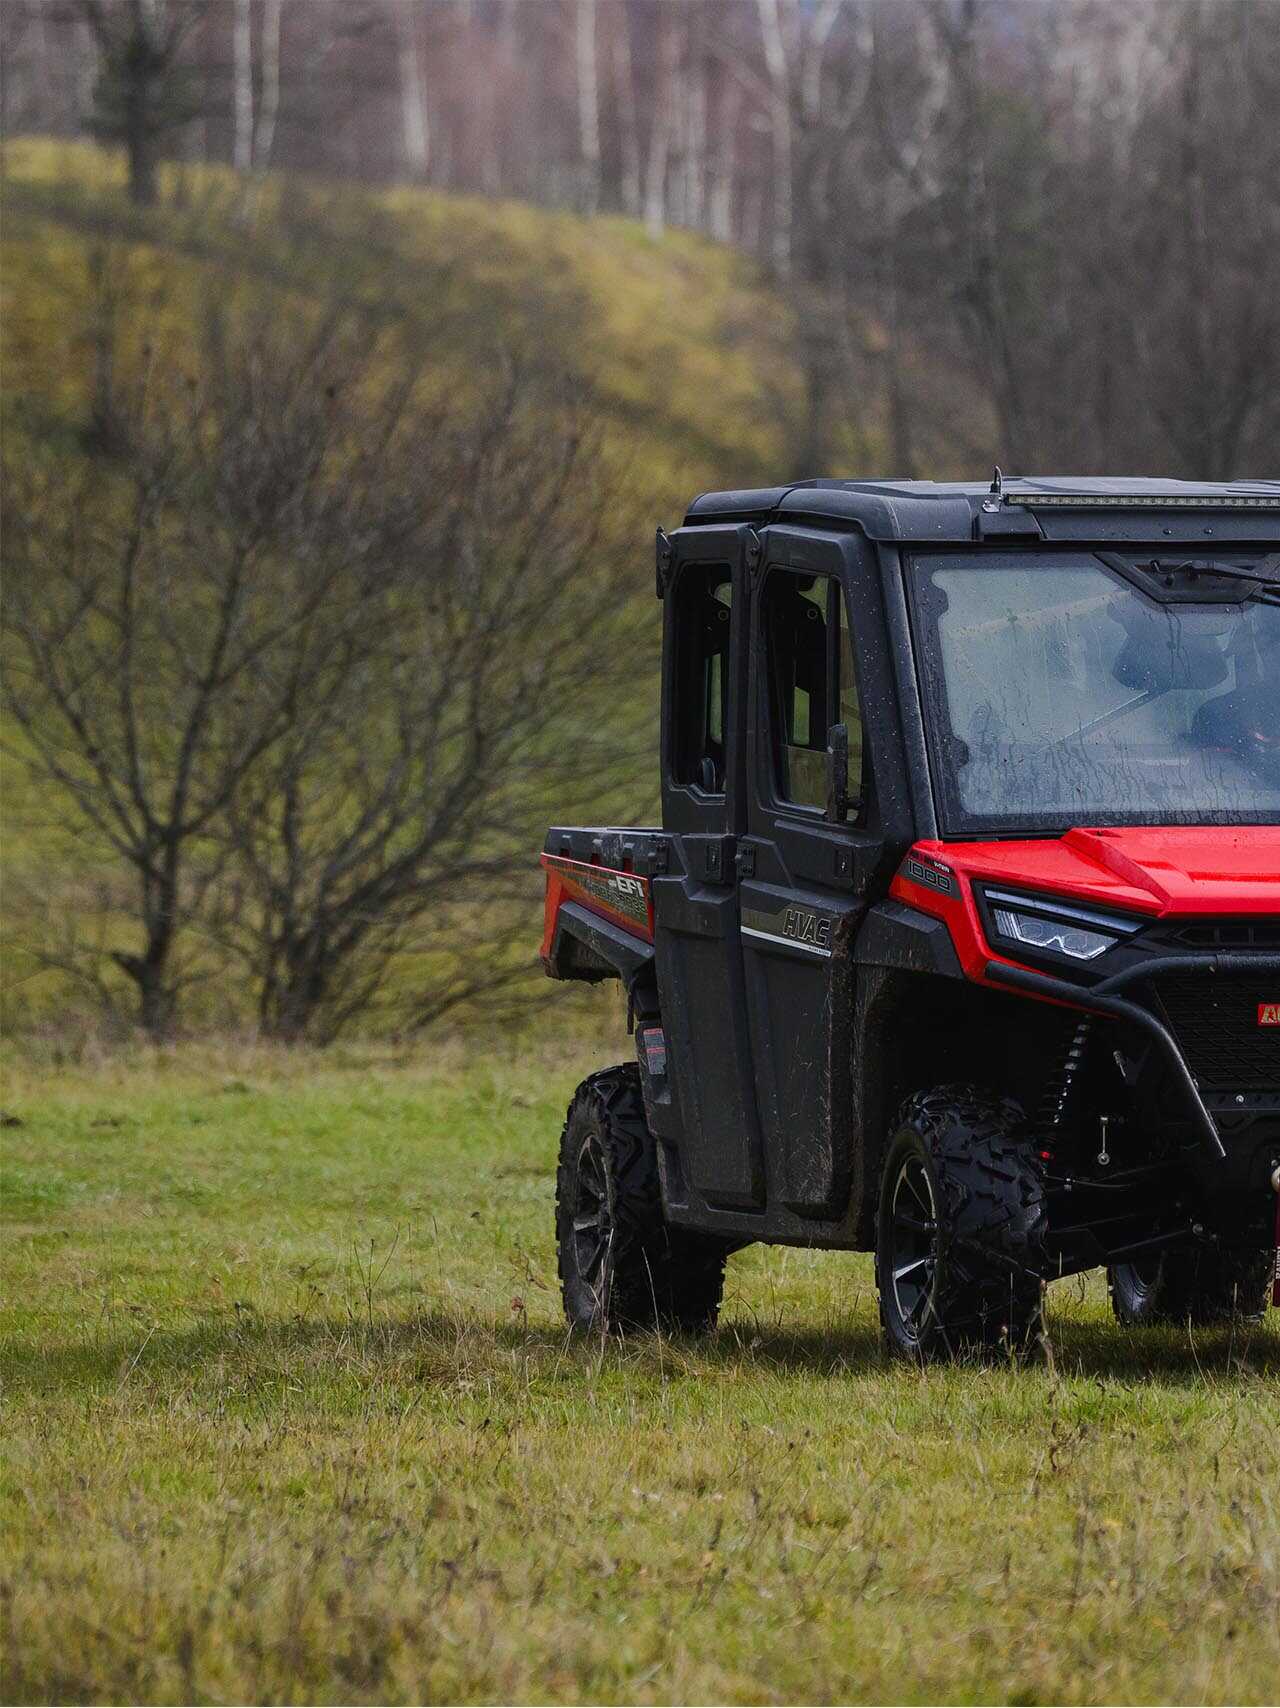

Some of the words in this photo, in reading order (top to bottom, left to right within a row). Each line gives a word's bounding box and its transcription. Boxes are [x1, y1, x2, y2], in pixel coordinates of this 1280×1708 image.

[615, 875, 645, 898] EFI
[907, 858, 952, 893] 1000
[782, 908, 832, 946] HVAC
